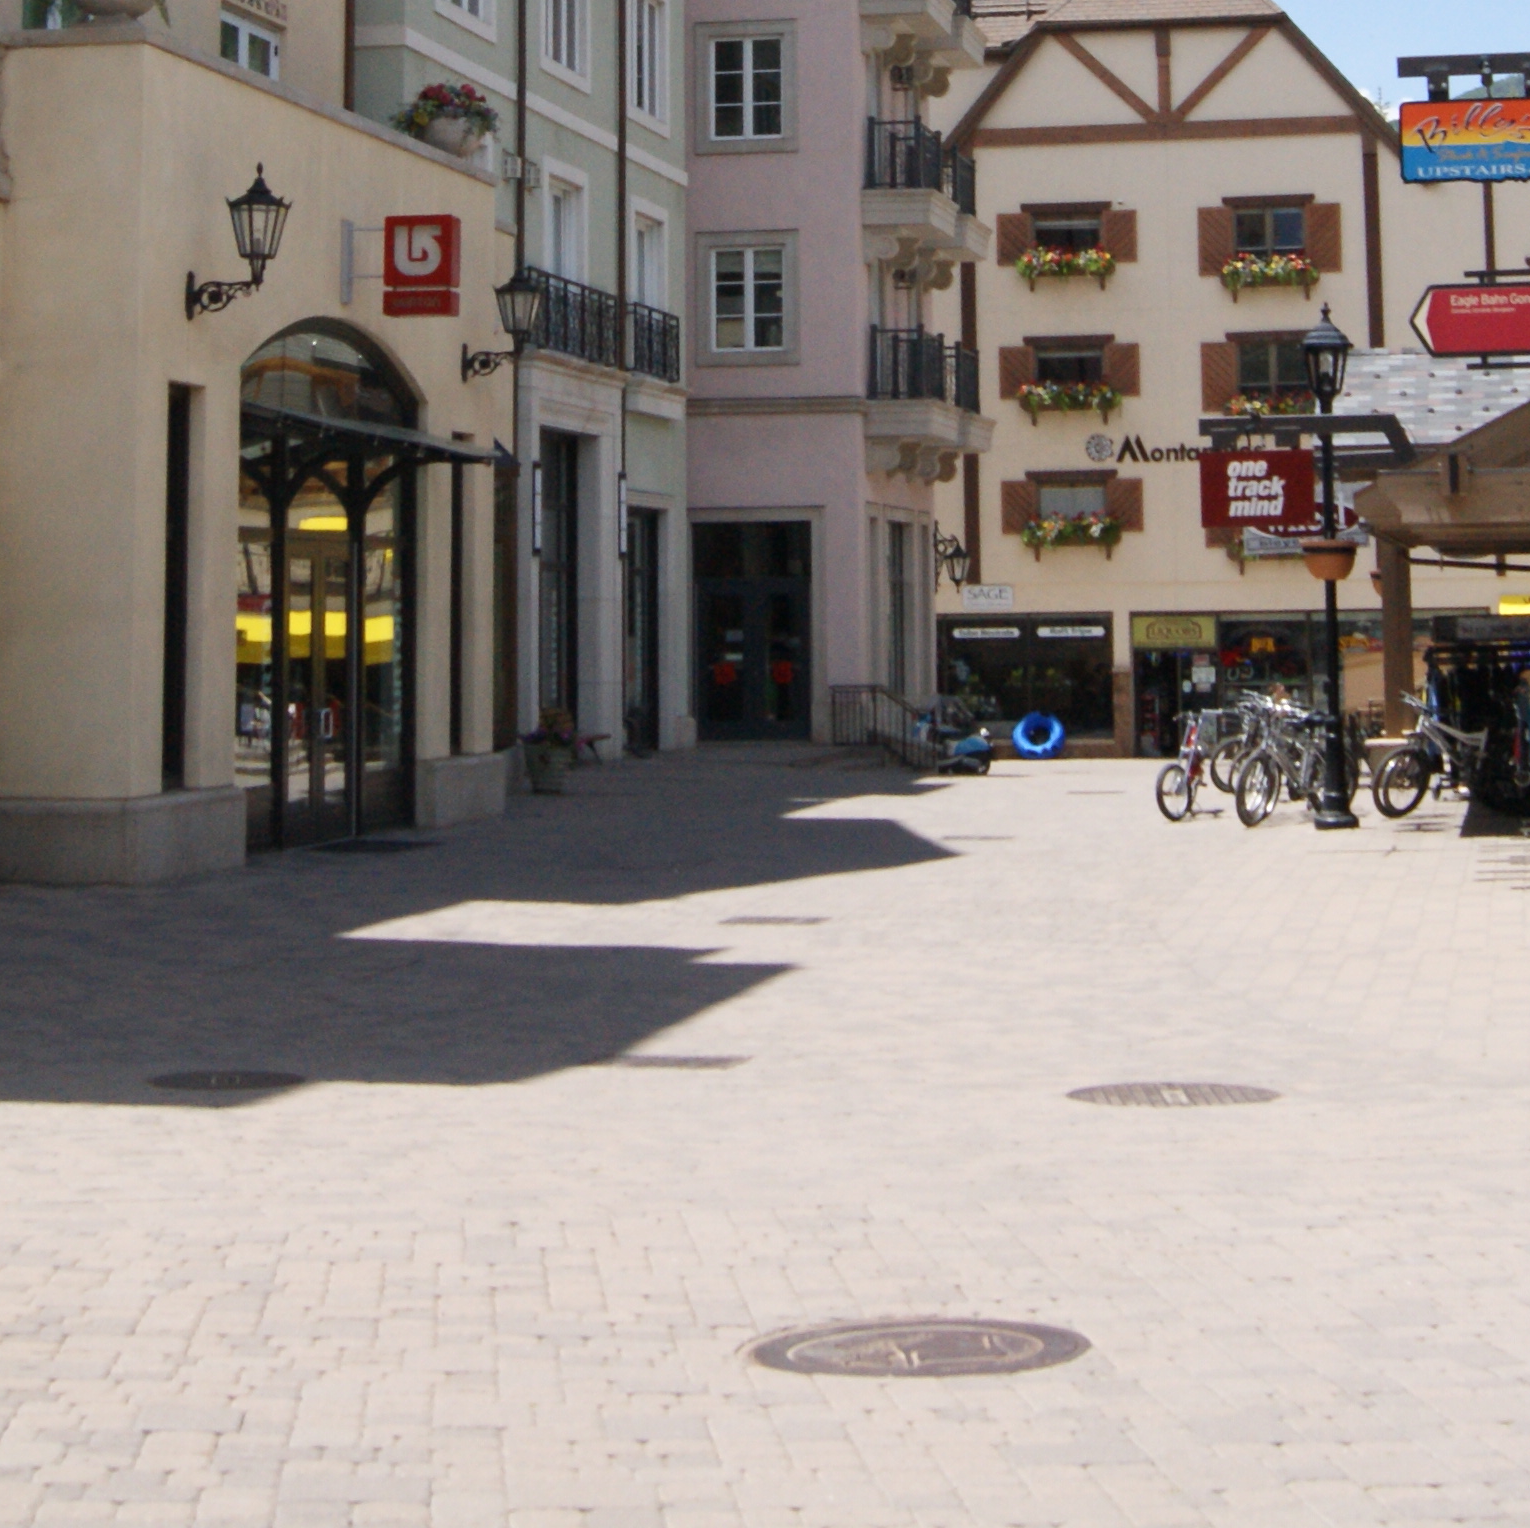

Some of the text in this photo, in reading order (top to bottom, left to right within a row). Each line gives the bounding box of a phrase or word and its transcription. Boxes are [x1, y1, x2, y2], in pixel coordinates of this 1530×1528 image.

[1417, 163, 1526, 178] UPSTAIRS
[1450, 294, 1479, 308] Eagle
[1480, 293, 1508, 305] Bahn
[1227, 460, 1268, 478] one
[1228, 476, 1286, 497] track
[1229, 496, 1284, 517] mind
[968, 588, 1008, 600] SAGE
